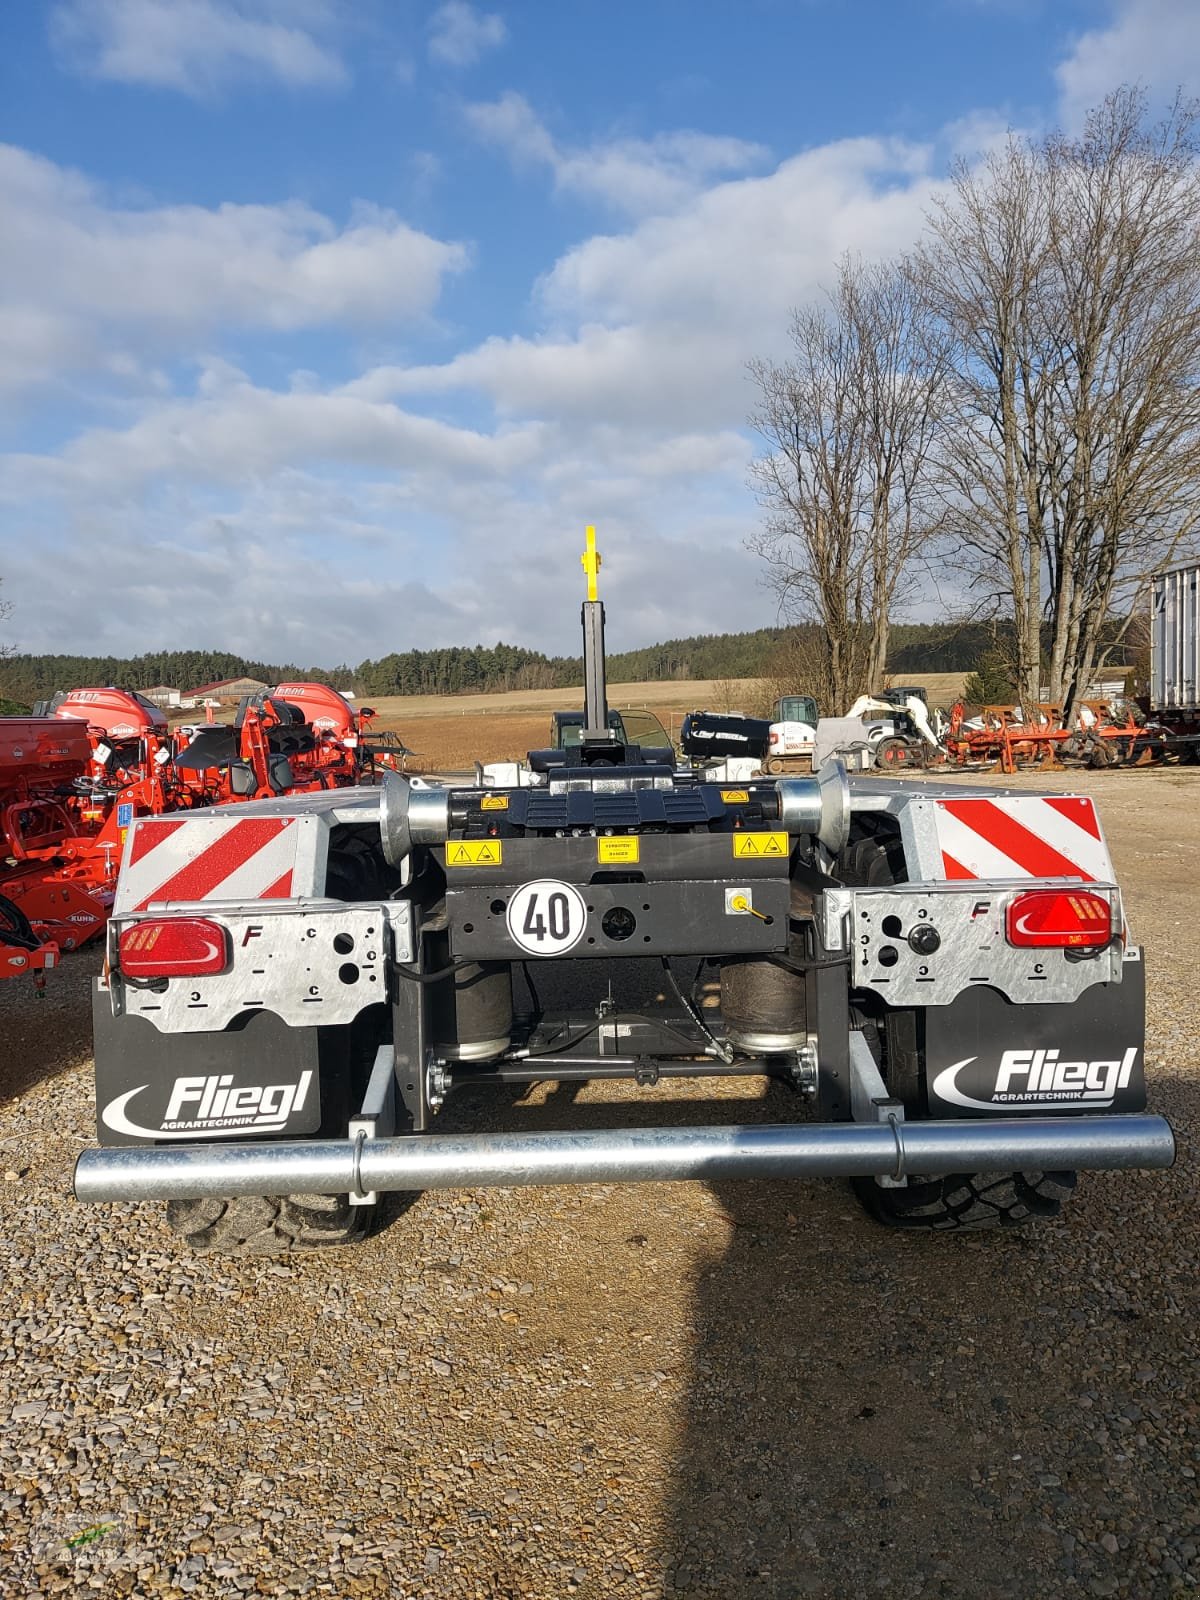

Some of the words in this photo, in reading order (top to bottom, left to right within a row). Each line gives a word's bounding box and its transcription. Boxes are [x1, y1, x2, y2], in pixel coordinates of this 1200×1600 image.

[523, 892, 571, 941] 40
[971, 901, 991, 919] F
[241, 925, 264, 947] F
[994, 1048, 1138, 1099] Fliegl
[164, 1070, 313, 1124] Fliegl
[991, 1091, 1084, 1102] AGRARTECHNIK
[160, 1116, 256, 1130] AGRARTECHNIK
